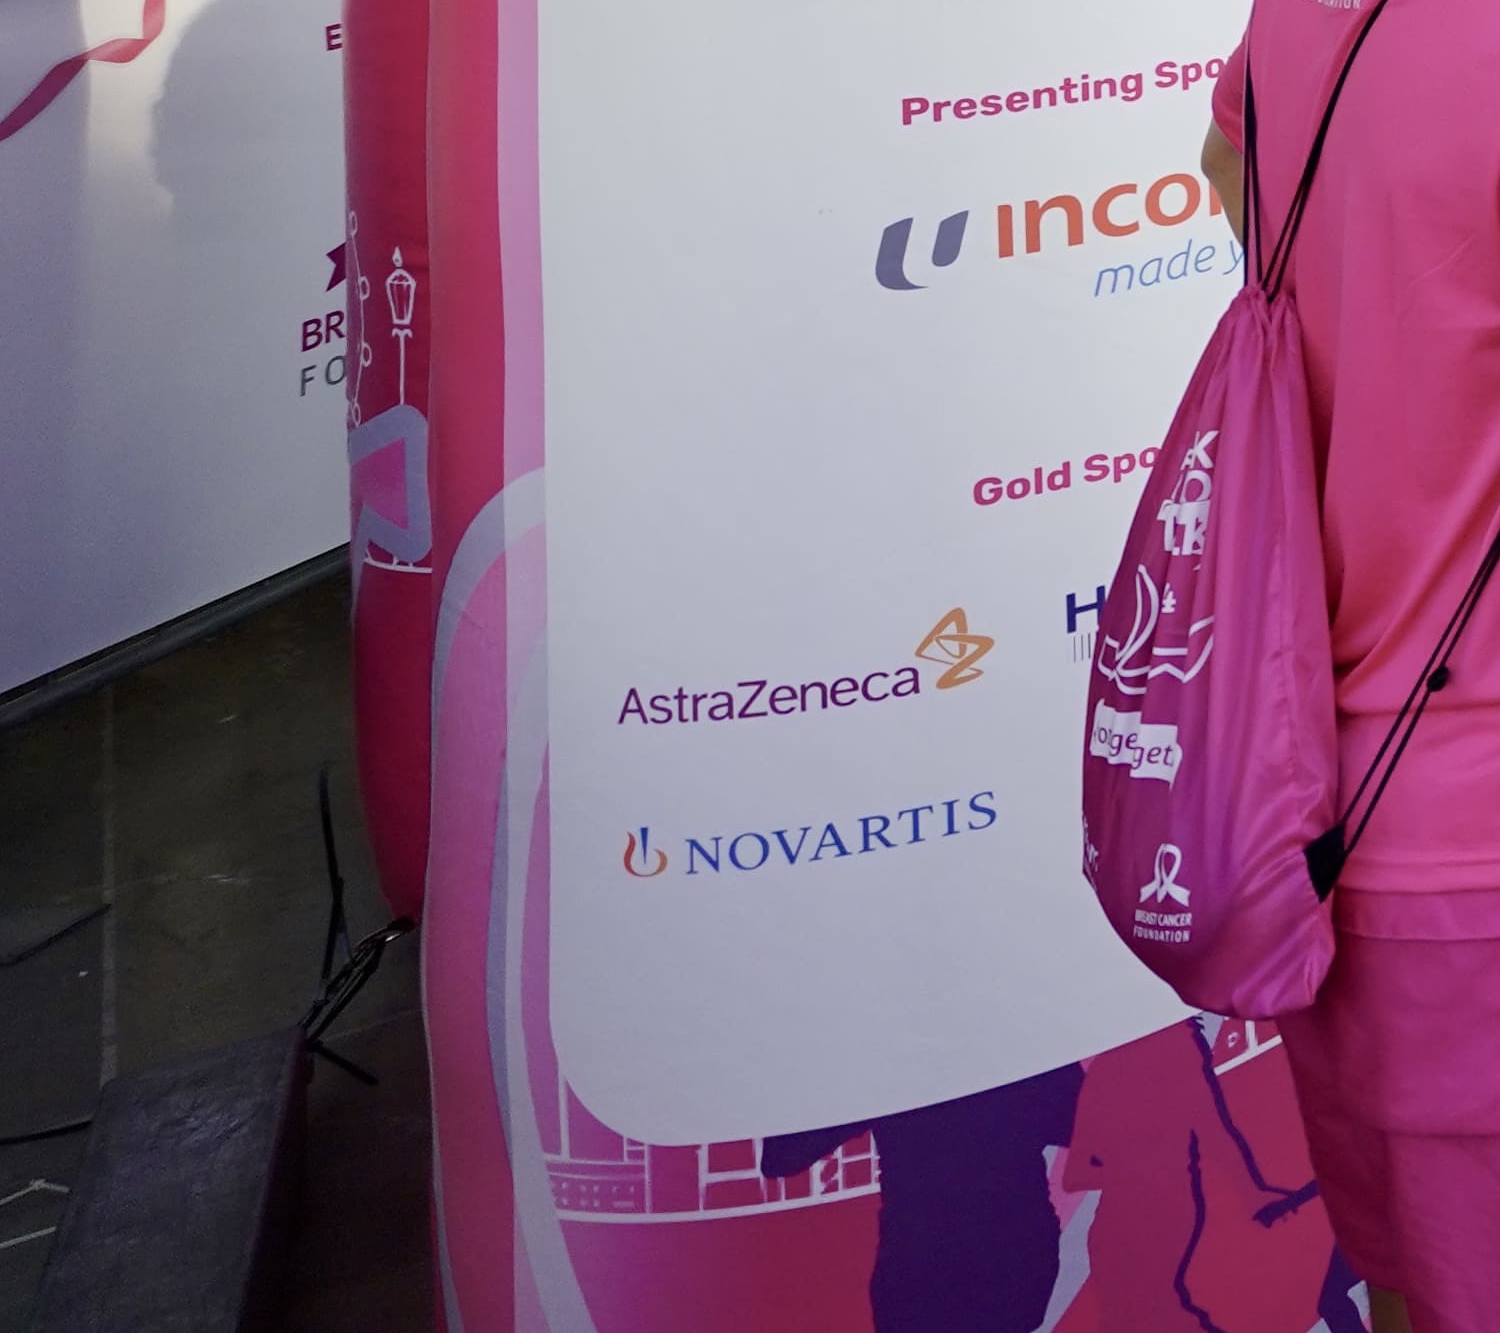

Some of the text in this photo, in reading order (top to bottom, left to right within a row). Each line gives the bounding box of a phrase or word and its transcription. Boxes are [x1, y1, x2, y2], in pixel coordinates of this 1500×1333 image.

[902, 72, 1143, 125] Presenting
[997, 173, 1224, 259] inco
[1094, 239, 1216, 297] made
[973, 461, 1071, 506] Gold
[618, 666, 920, 725] AstraZeneca
[685, 791, 998, 875] NOVARTIS
